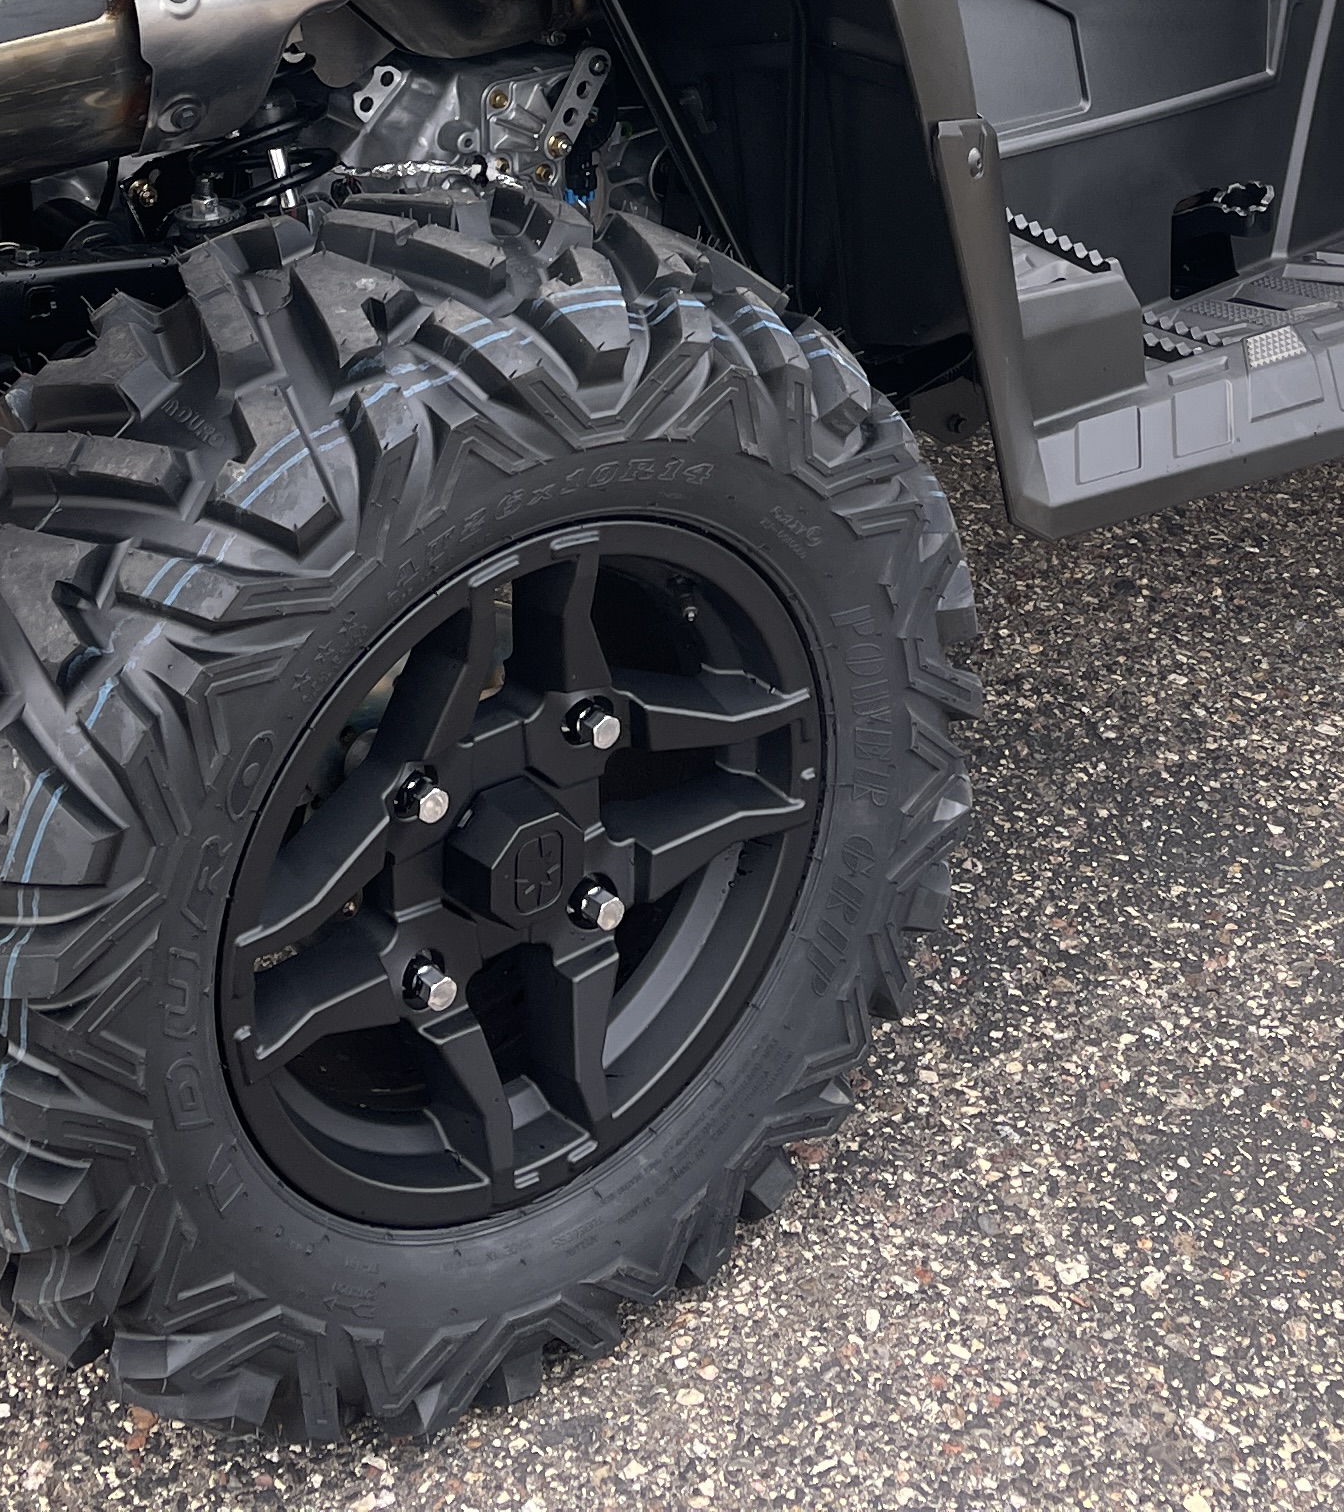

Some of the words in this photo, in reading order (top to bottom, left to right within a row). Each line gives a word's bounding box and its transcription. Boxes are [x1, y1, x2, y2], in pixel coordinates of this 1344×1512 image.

[829, 604, 893, 807] POWER
[164, 730, 275, 1130] DURO
[806, 833, 877, 998] GRIP
